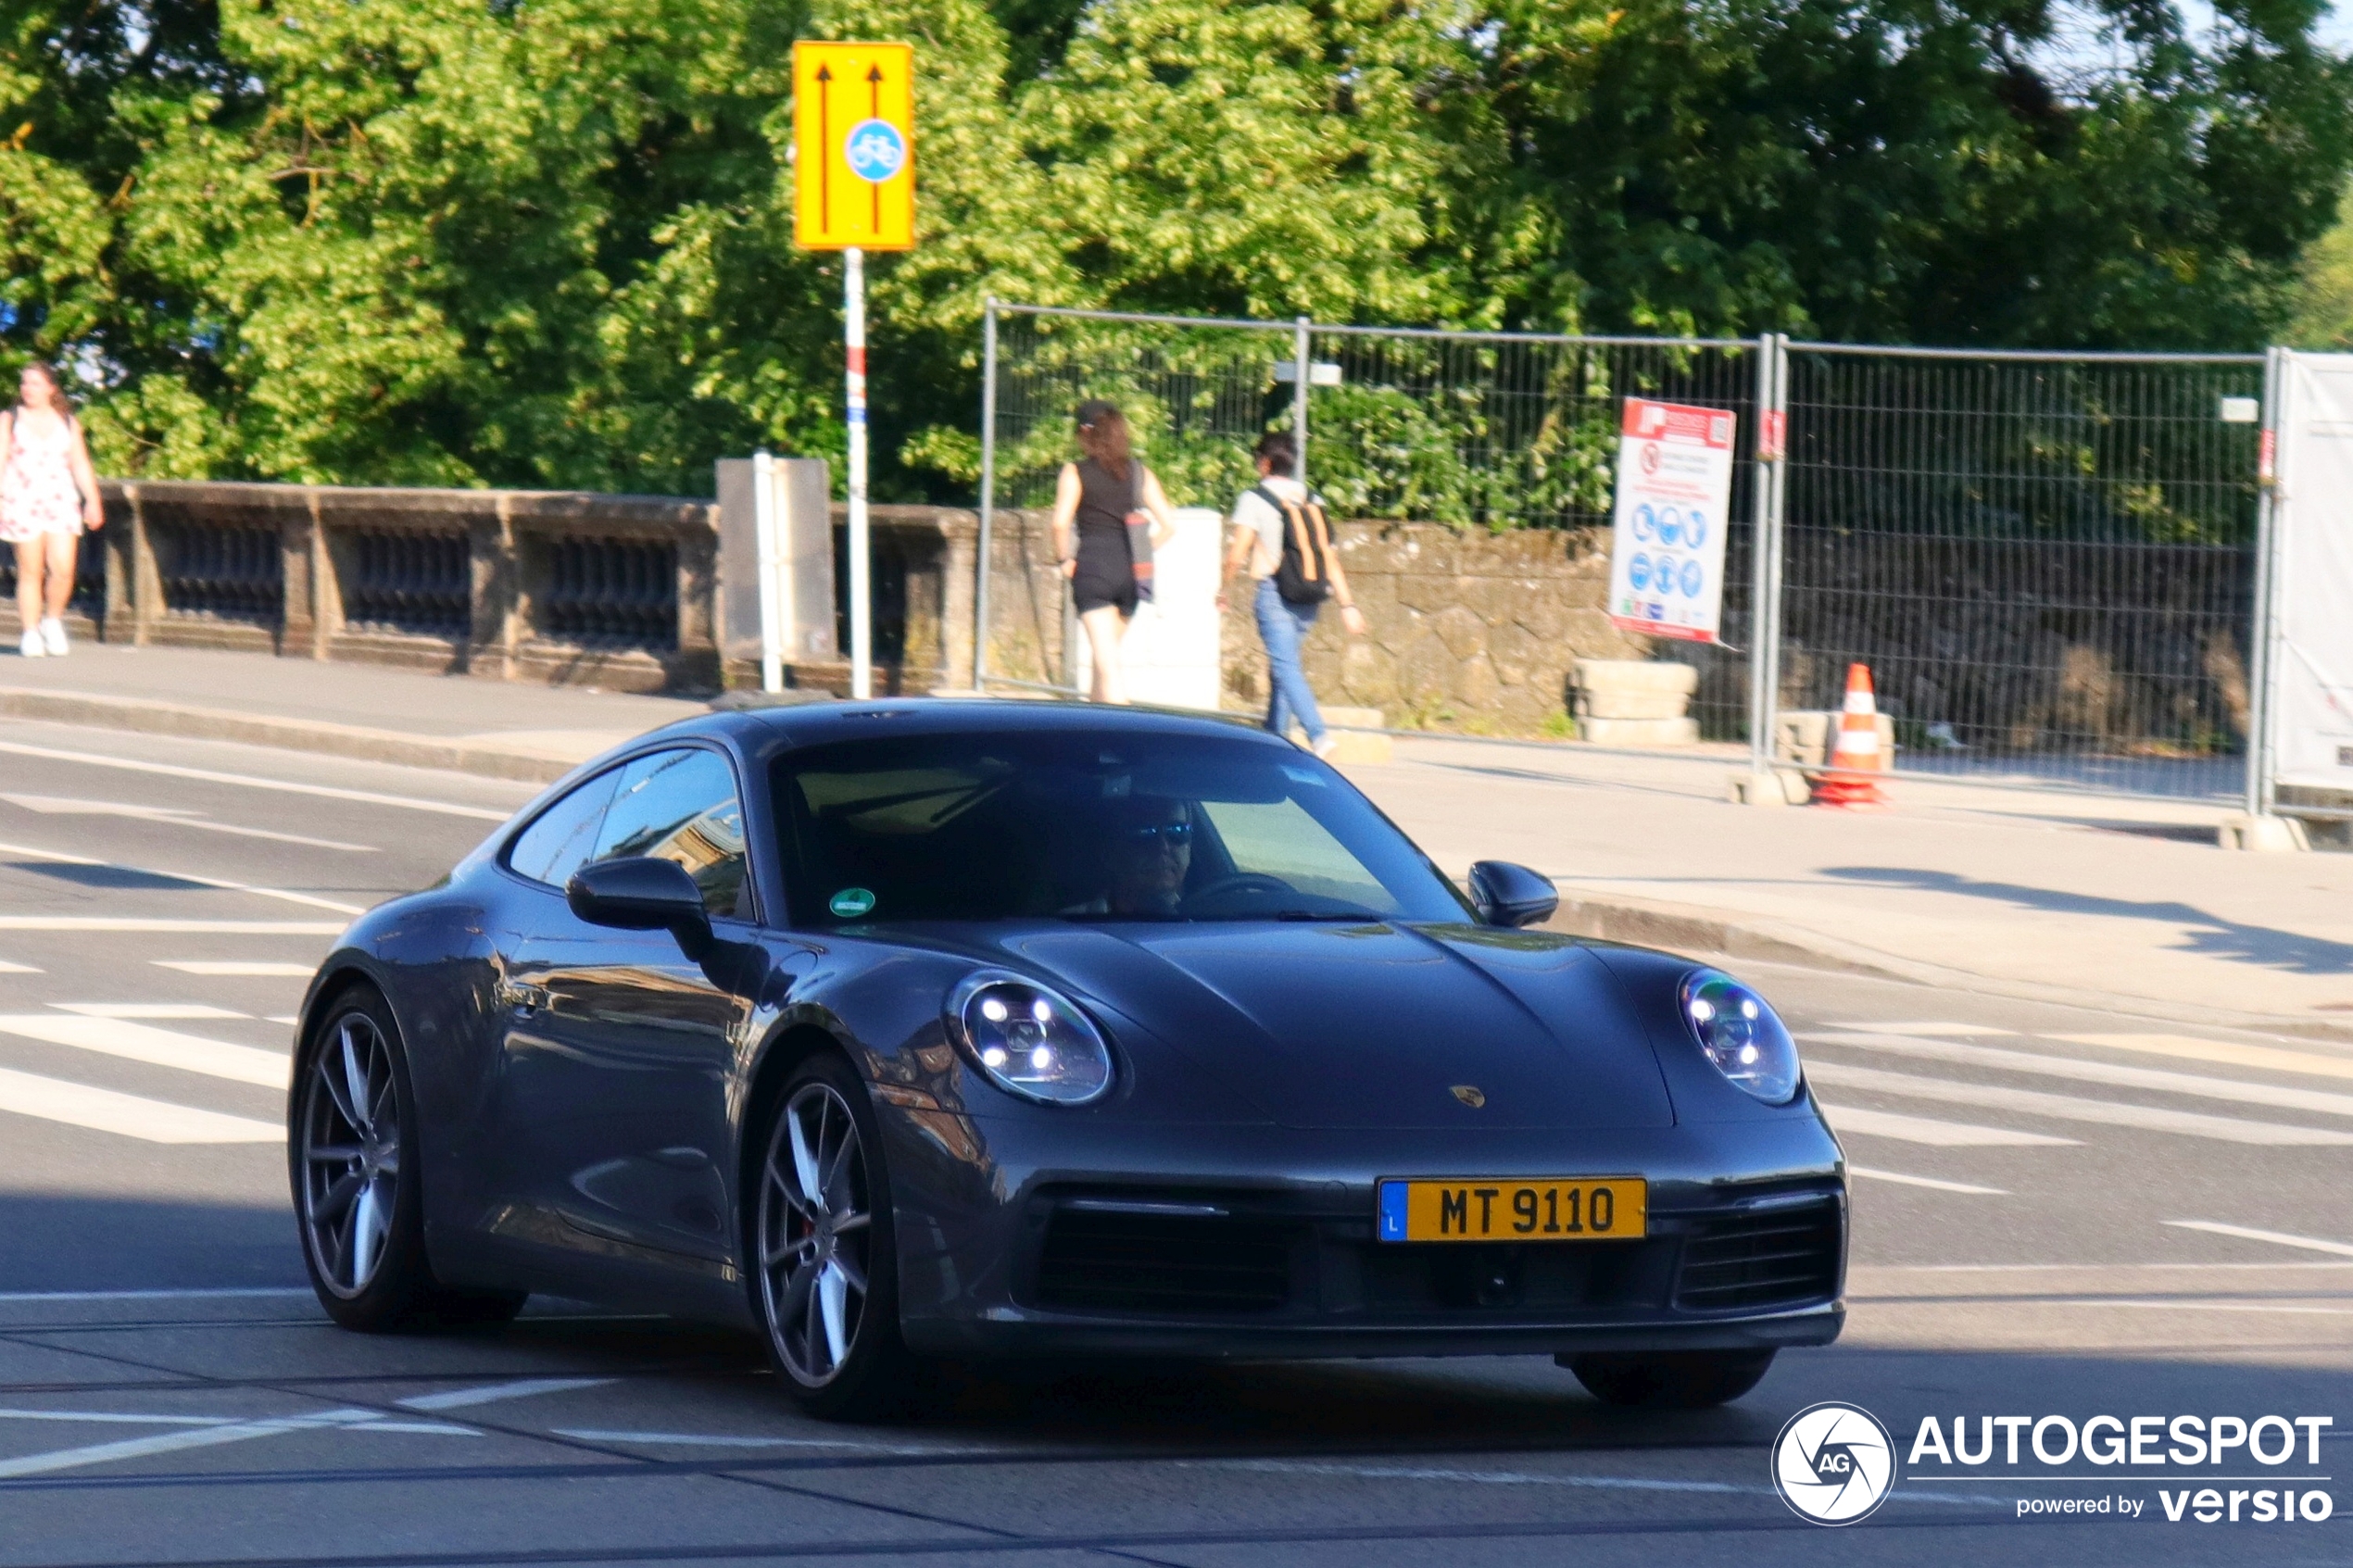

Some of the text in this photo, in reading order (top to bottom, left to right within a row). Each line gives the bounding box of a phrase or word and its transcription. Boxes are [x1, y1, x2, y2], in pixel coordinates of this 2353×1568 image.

[1389, 1216, 1398, 1232] L
[1441, 1186, 1614, 1234] MT 9110
